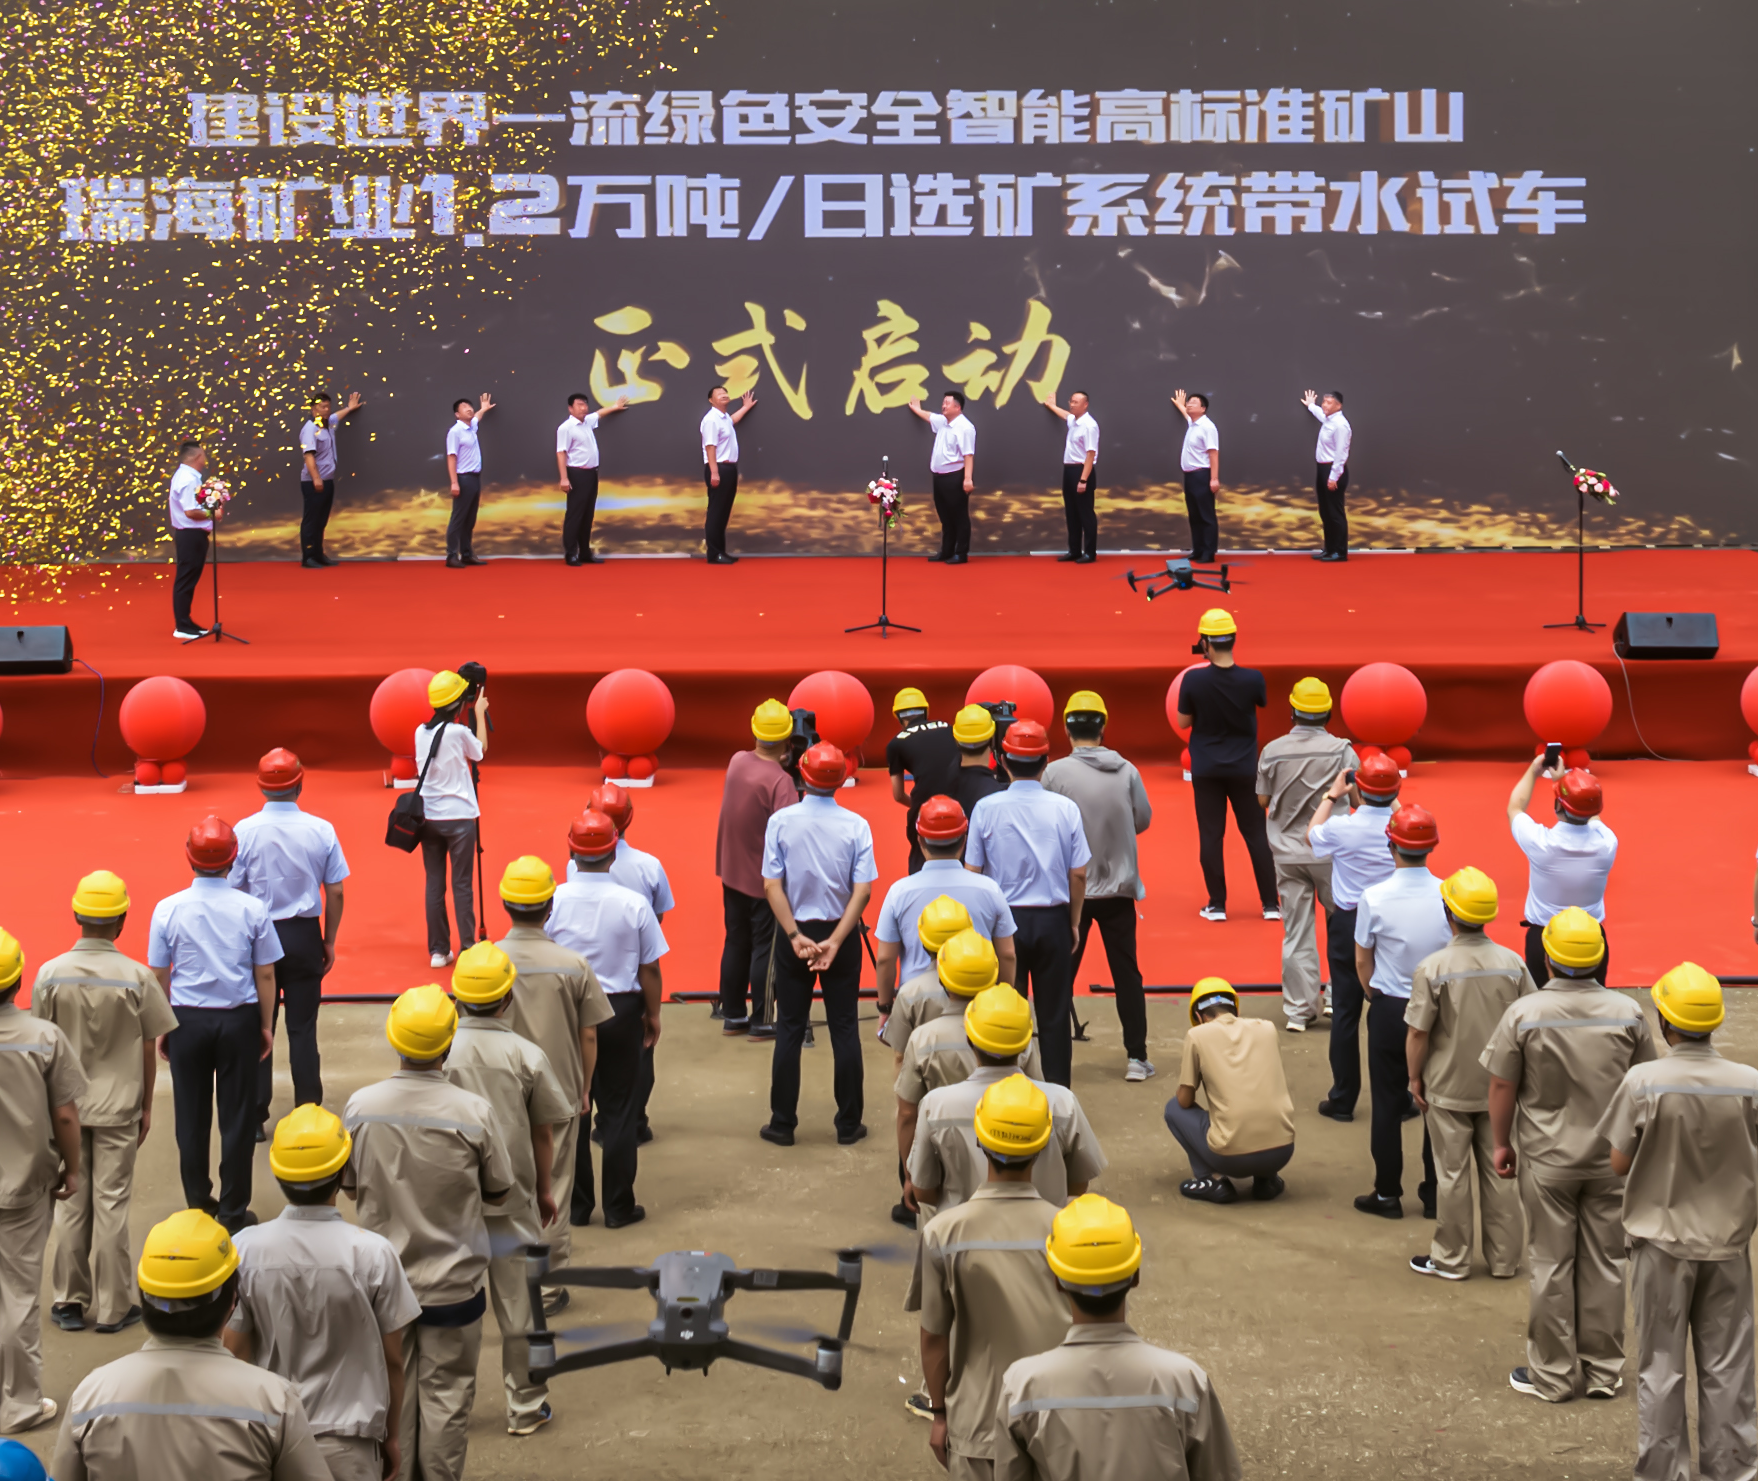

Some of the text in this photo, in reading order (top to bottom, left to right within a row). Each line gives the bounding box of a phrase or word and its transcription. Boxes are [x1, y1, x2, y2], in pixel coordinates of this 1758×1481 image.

[187, 89, 1464, 146] 建设世界一流绿色安全智能高标准矿山
[58, 171, 1587, 246] 瑞海矿业1.2万吨/日选矿系统带水试车
[589, 299, 1072, 420] 正式启动
